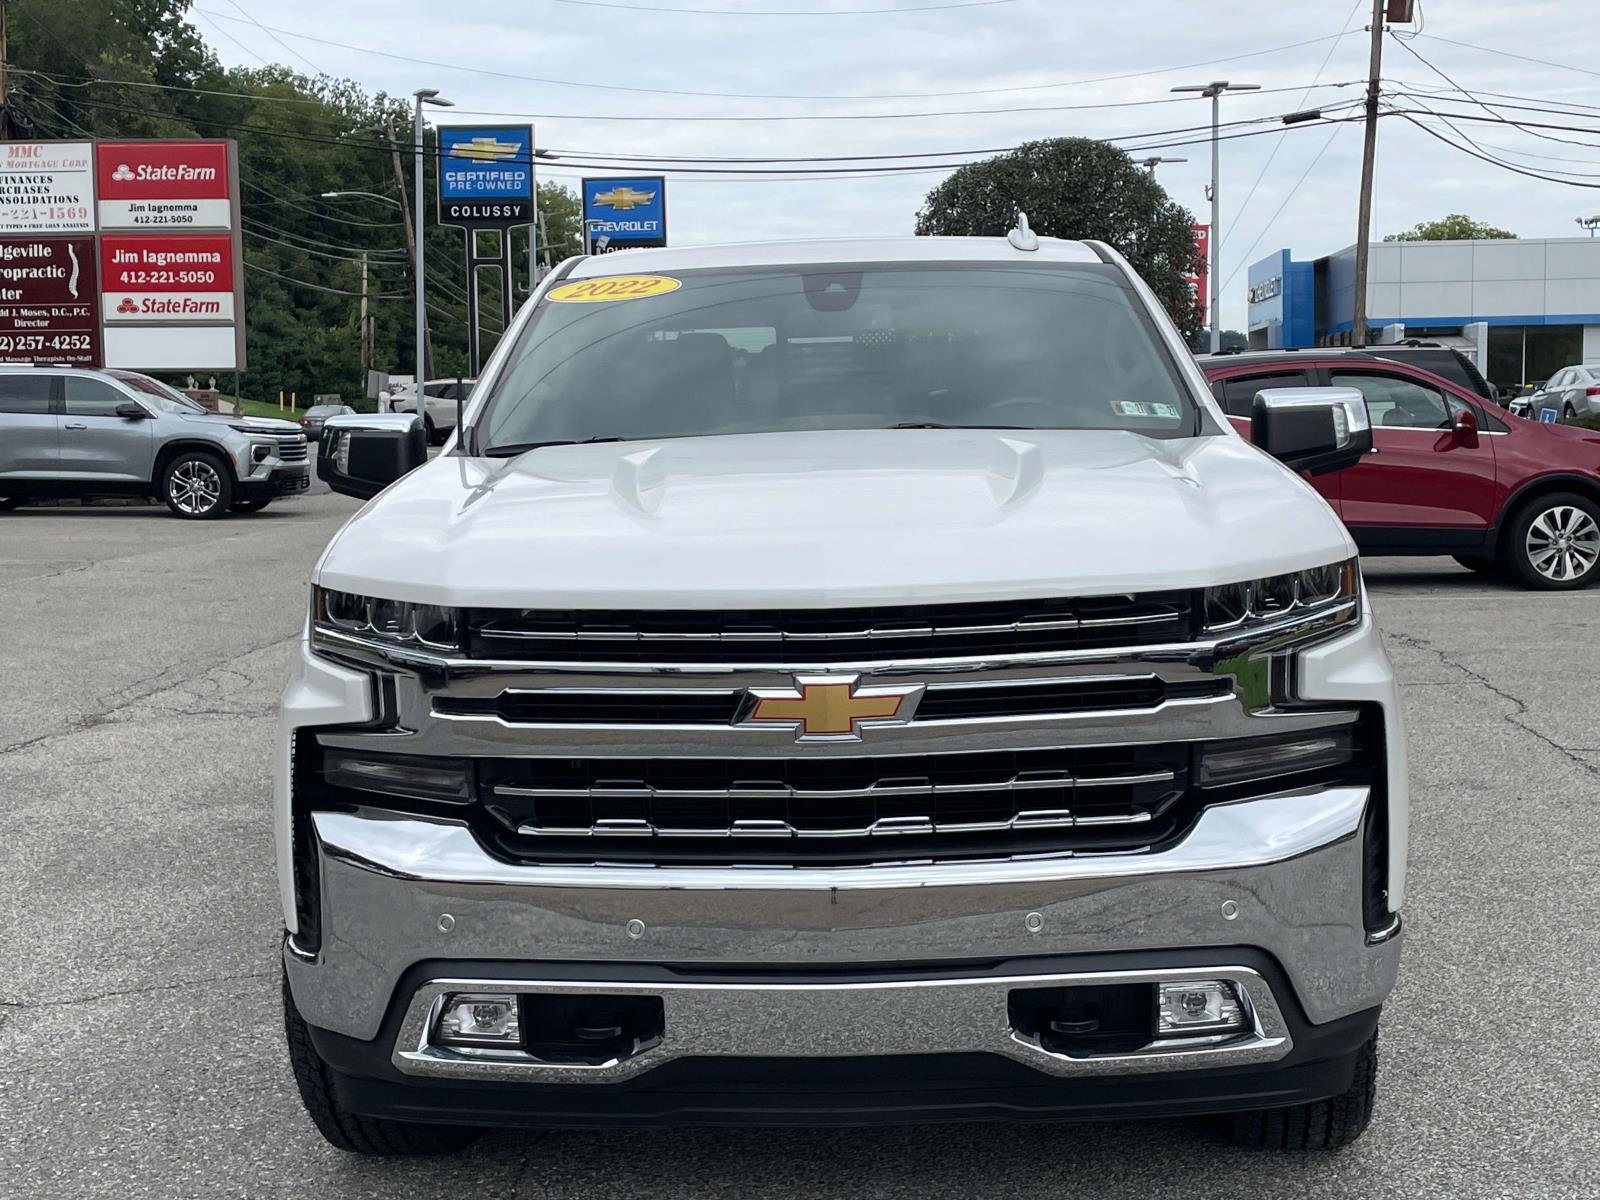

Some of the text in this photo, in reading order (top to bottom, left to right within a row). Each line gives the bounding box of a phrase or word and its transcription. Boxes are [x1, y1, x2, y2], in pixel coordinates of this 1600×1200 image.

[8, 145, 43, 158] MMC
[445, 171, 526, 181] CERTIFIED
[449, 181, 522, 190] PRE-OWNED
[128, 203, 145, 212] Jim
[451, 205, 521, 217] COLUSSY
[134, 215, 193, 223] 412-221-5050
[590, 221, 659, 232] CHEVROLET
[112, 249, 221, 266] Jim Iagnemma
[120, 271, 215, 283] 412-221-5050
[565, 279, 662, 299] 2022
[14, 319, 50, 327] Director
[16, 335, 91, 350] 257-4252
